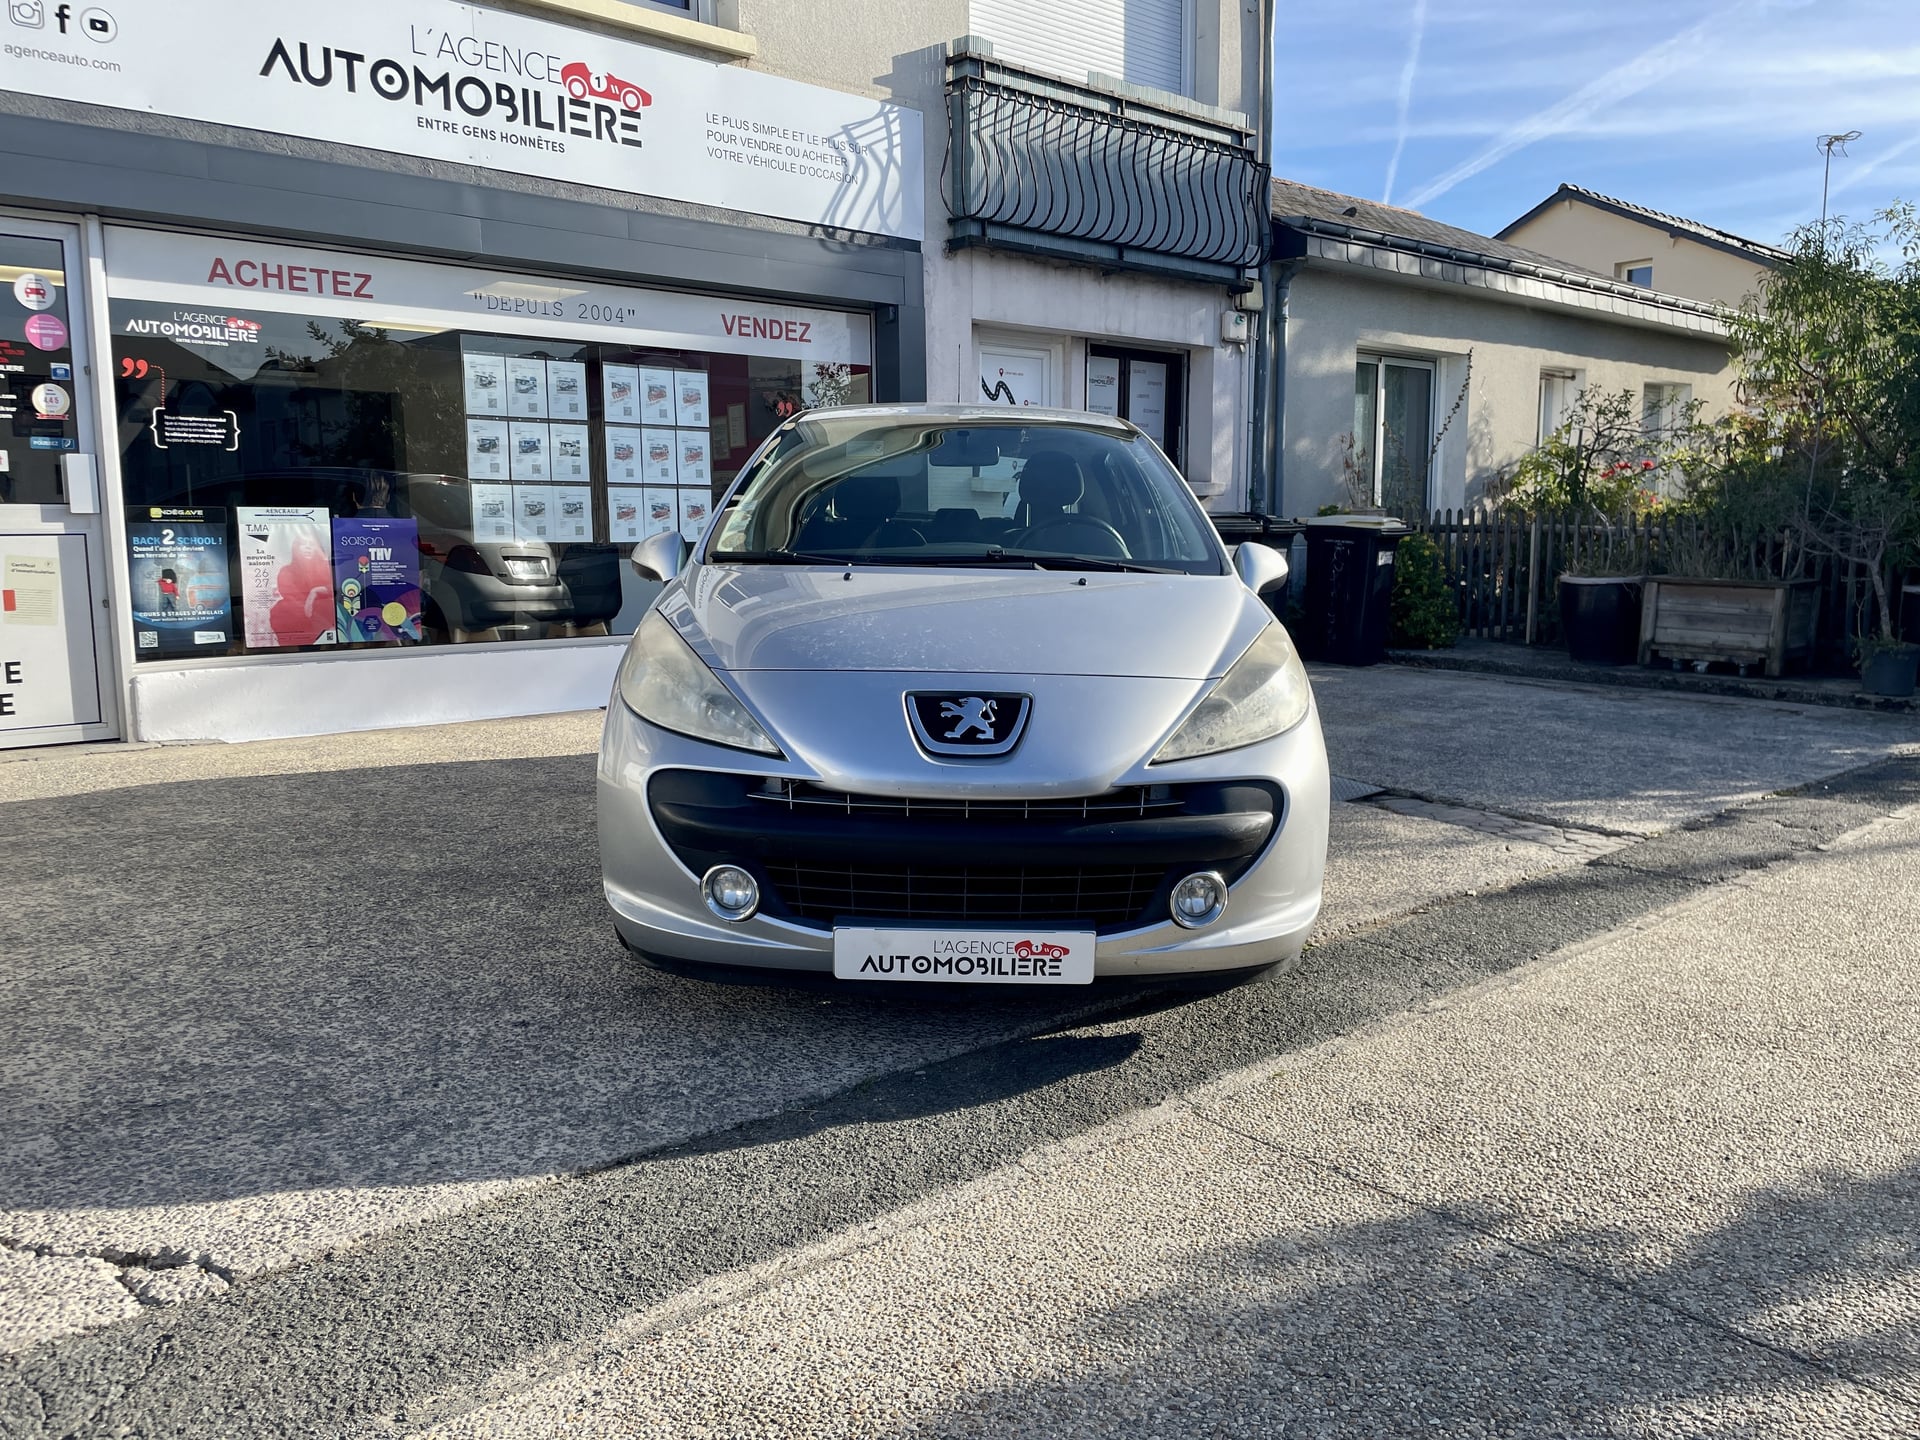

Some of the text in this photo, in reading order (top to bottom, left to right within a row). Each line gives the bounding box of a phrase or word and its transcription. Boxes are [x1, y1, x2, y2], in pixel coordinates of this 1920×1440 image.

[3, 42, 122, 73] agenceauto.com
[410, 23, 563, 85] L'AGENCE
[417, 116, 566, 154] ENTRE GENS HONNÊTES
[706, 112, 868, 156] LE PLUS SIMPLE ET LE PLUS SÛR
[706, 130, 848, 167] POUR VENDRE OU ACHETER
[707, 146, 858, 185] VOTRE VÉHICULE D'OCCASION
[207, 257, 374, 299] ACHETEZ
[173, 311, 228, 326] L'AGENCE
[721, 313, 812, 344] VENDEZ
[132, 536, 160, 545] BACK
[161, 529, 175, 545] 2
[177, 536, 217, 545] SCHOOL
[368, 547, 392, 561] THV
[254, 567, 269, 578] 26
[255, 578, 270, 588] 27
[0, 661, 23, 684] E
[933, 939, 1015, 955] L'AGENCE
